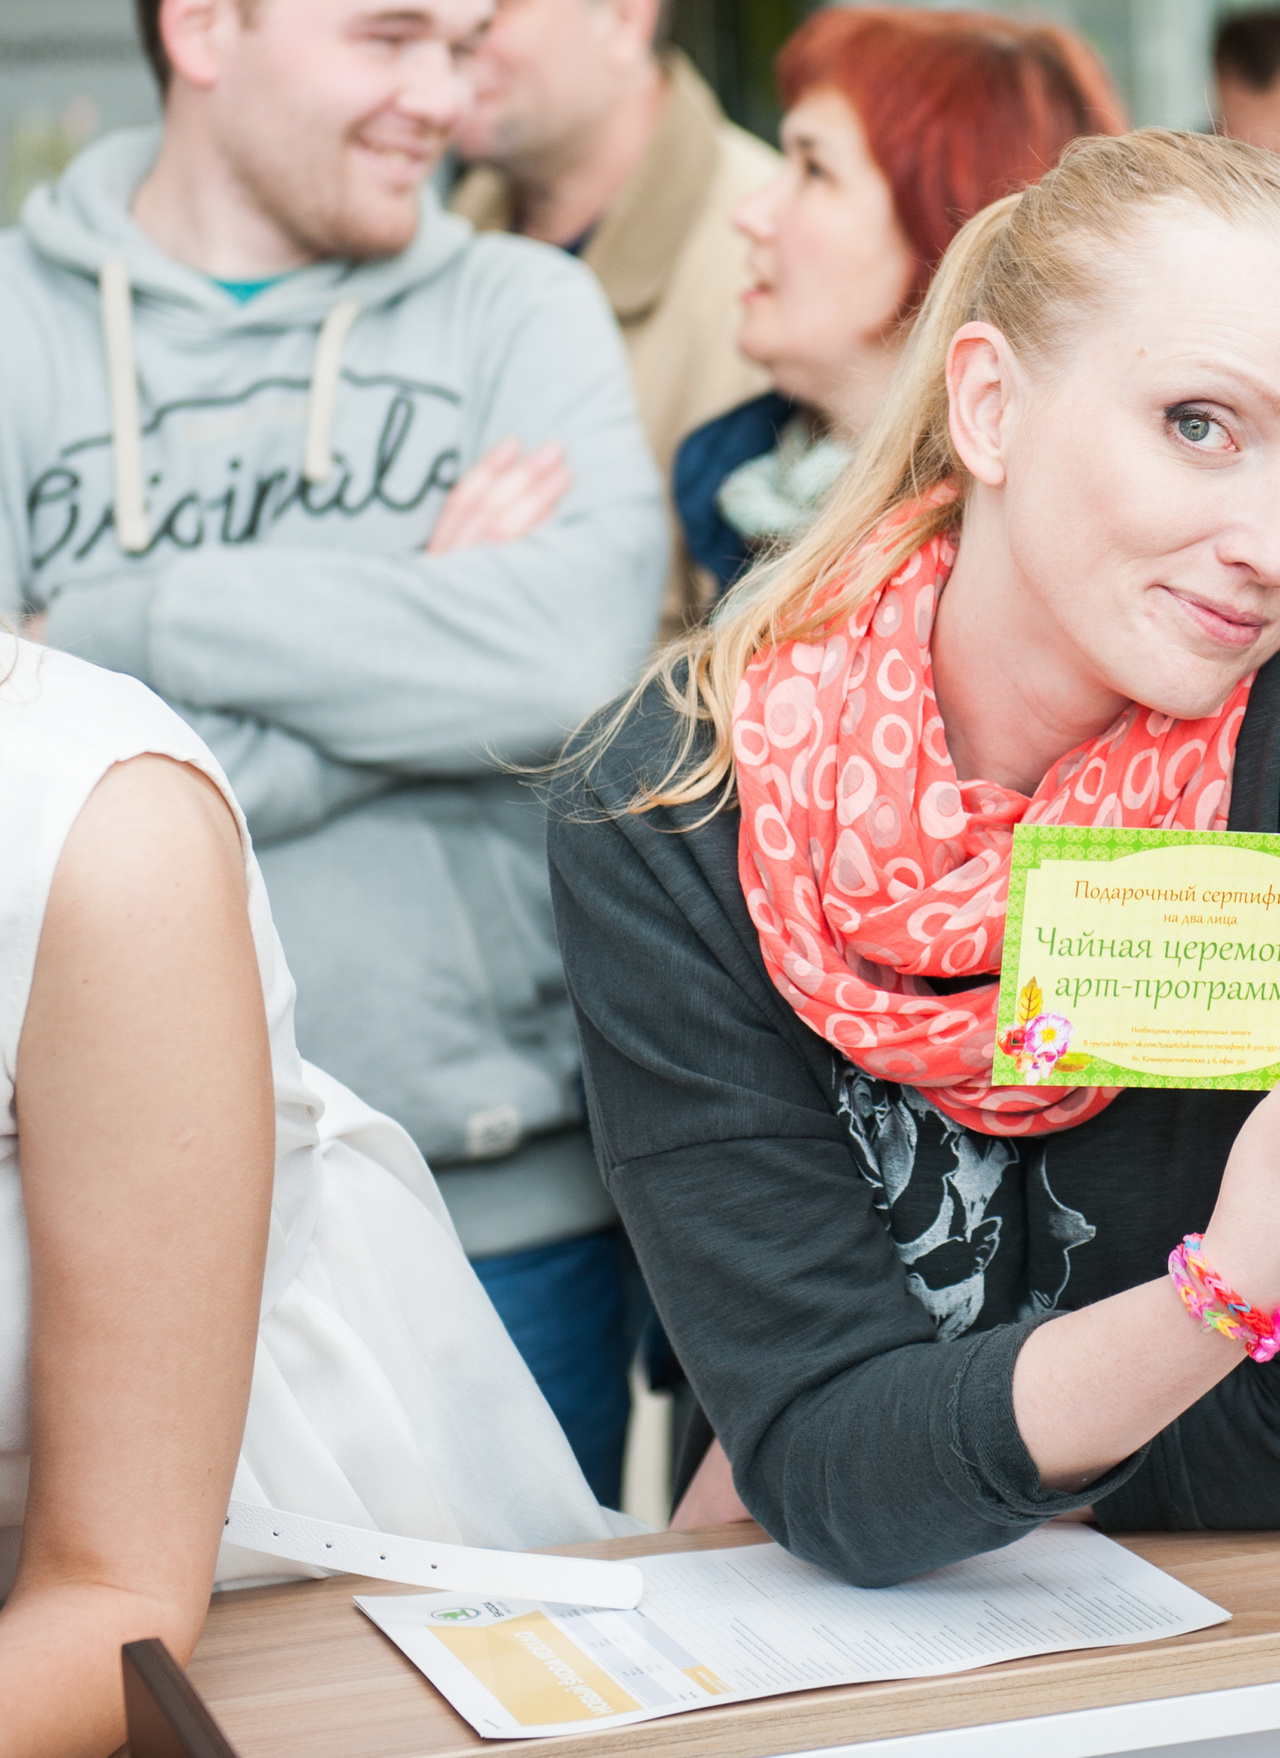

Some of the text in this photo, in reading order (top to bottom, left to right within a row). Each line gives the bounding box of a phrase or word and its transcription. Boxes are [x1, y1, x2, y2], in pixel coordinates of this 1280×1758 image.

[1074, 880, 1197, 906] Подарочный
[1163, 912, 1239, 927] на два лица
[1035, 926, 1153, 960] Чайная
